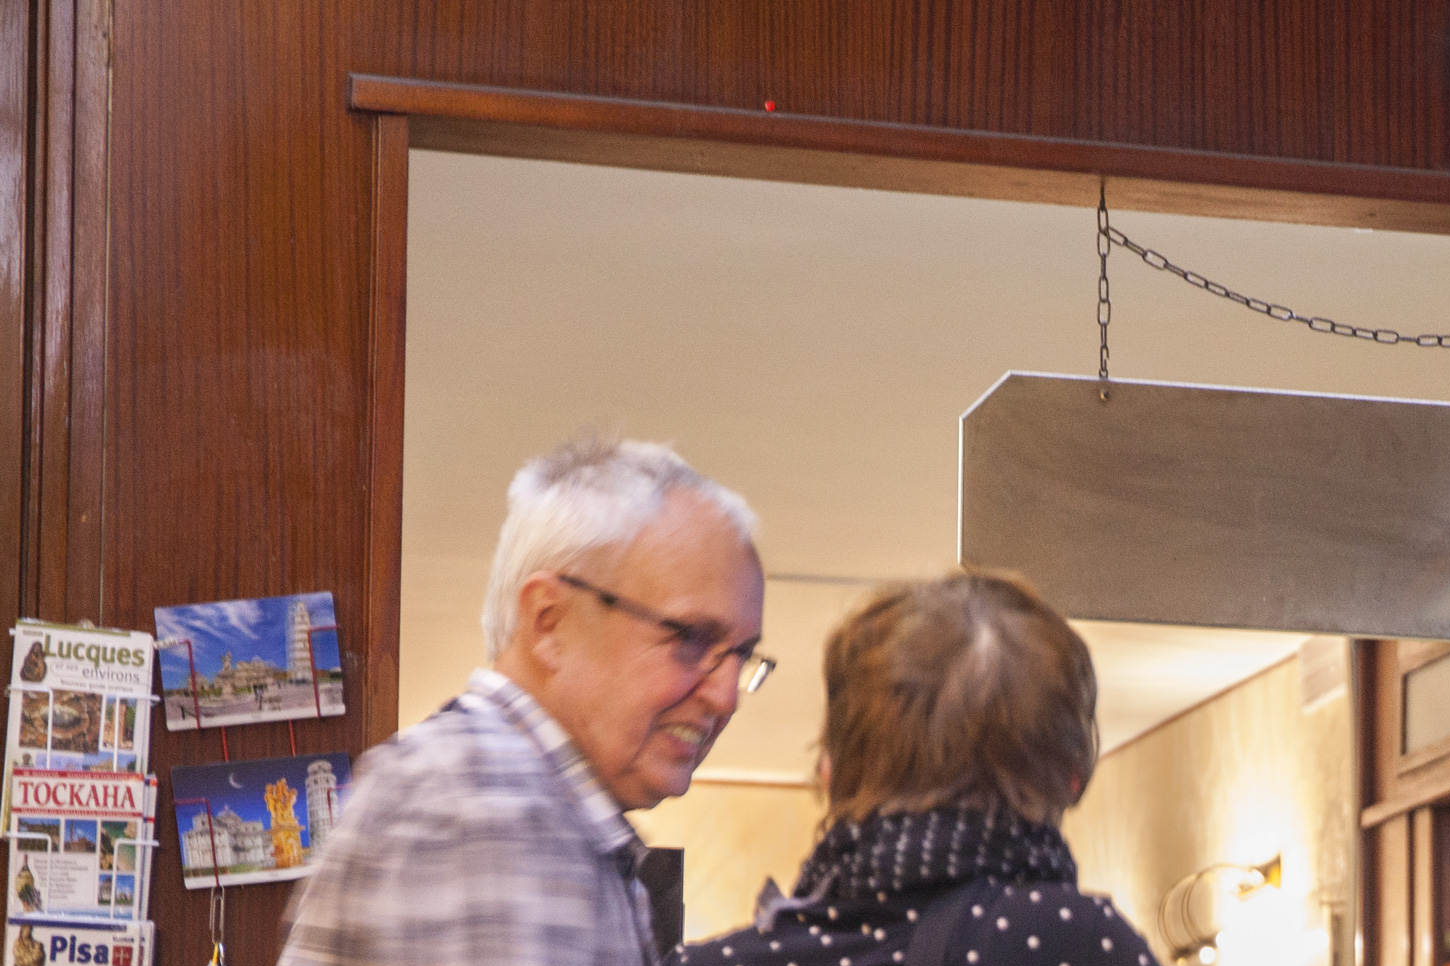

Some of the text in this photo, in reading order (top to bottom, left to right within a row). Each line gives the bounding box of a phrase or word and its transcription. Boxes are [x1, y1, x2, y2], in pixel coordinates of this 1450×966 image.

[44, 634, 145, 667] Lucques
[82, 665, 140, 683] environs
[50, 935, 109, 964] Pisa
